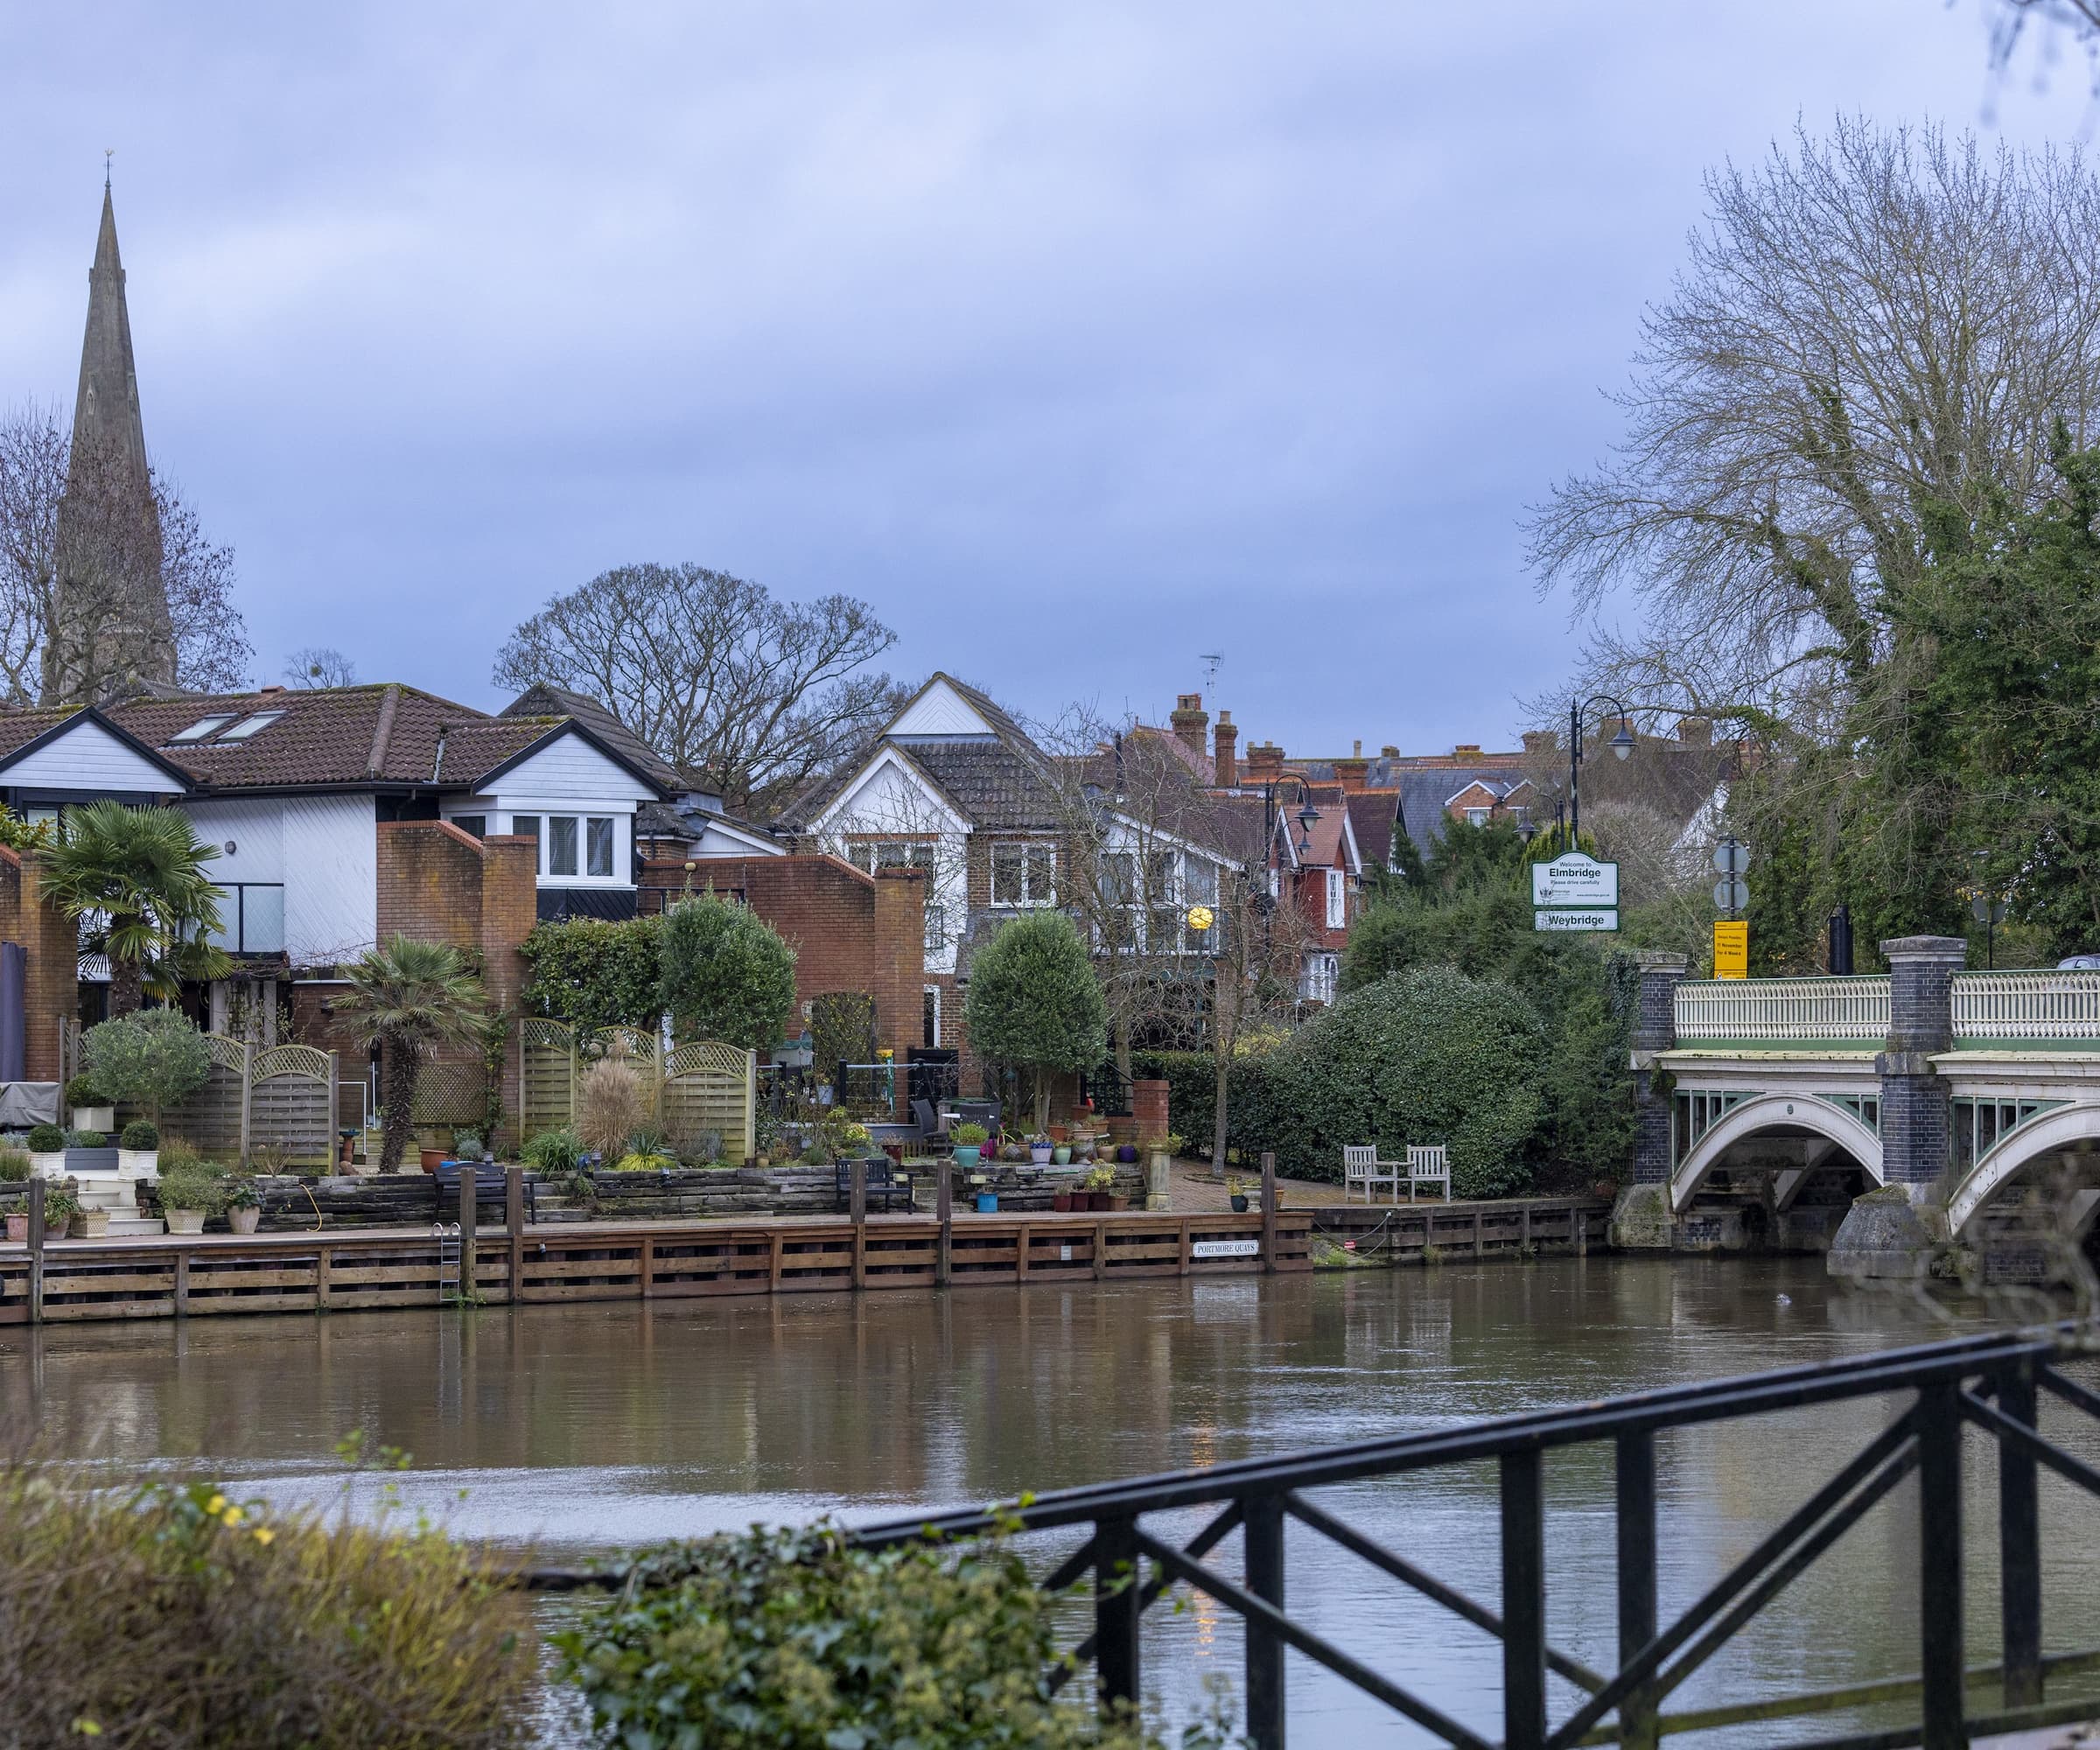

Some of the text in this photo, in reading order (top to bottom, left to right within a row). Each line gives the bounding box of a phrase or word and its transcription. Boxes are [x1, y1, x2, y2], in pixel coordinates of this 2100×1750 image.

[1549, 868, 1601, 878] Elmbridge
[1549, 915, 1604, 927] Weybridge
[1198, 1243, 1255, 1253] PORTMORE QUAYS
